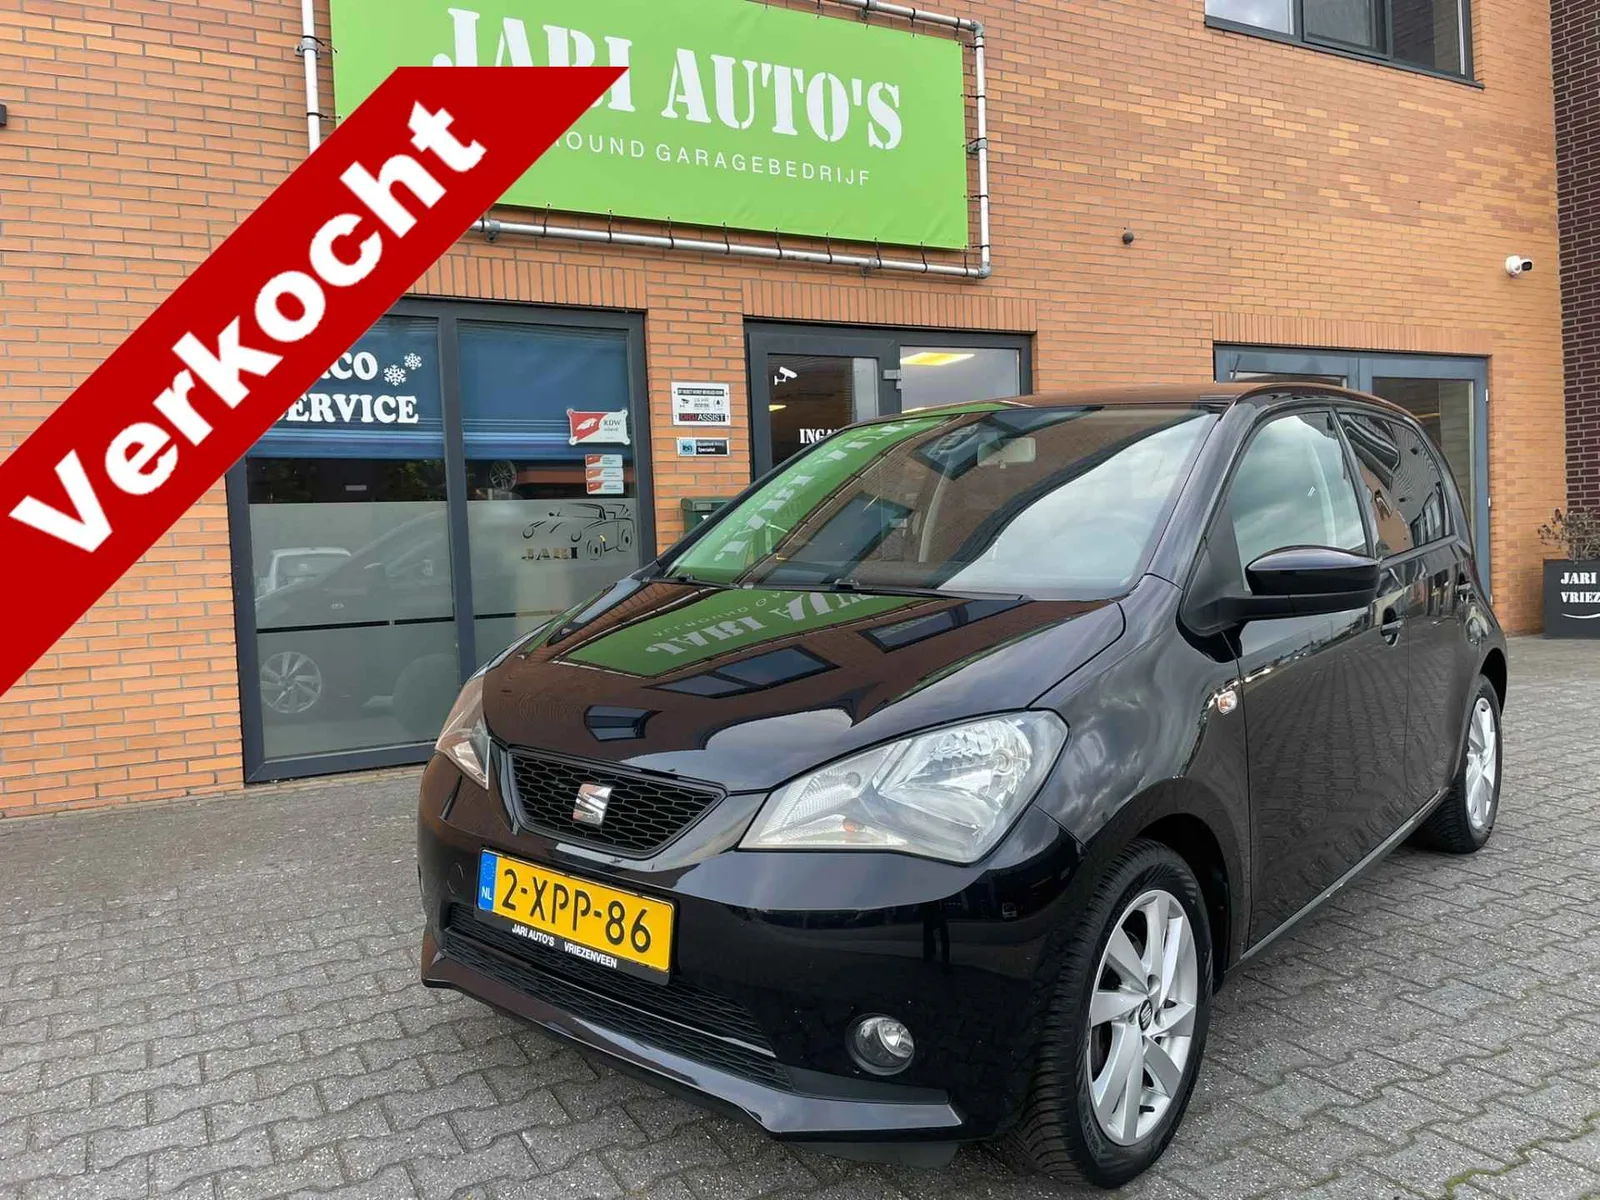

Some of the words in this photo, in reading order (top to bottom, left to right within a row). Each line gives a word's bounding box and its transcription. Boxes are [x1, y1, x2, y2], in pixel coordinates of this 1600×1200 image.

[661, 47, 903, 150] AUTO'S
[555, 131, 645, 158] OUND
[656, 144, 870, 186] GARAGEBEDRIJF
[321, 351, 378, 380] CO
[278, 393, 419, 424] ERVICE
[799, 428, 840, 443] ING
[1560, 572, 1597, 584] JARI
[1560, 591, 1600, 603] VRIEZ
[481, 886, 493, 900] NL
[502, 868, 652, 954] 2-XPP-86
[512, 923, 528, 937] JARI
[528, 930, 555, 947] AUTO'S
[564, 941, 618, 969] VRIEZENVEEN
